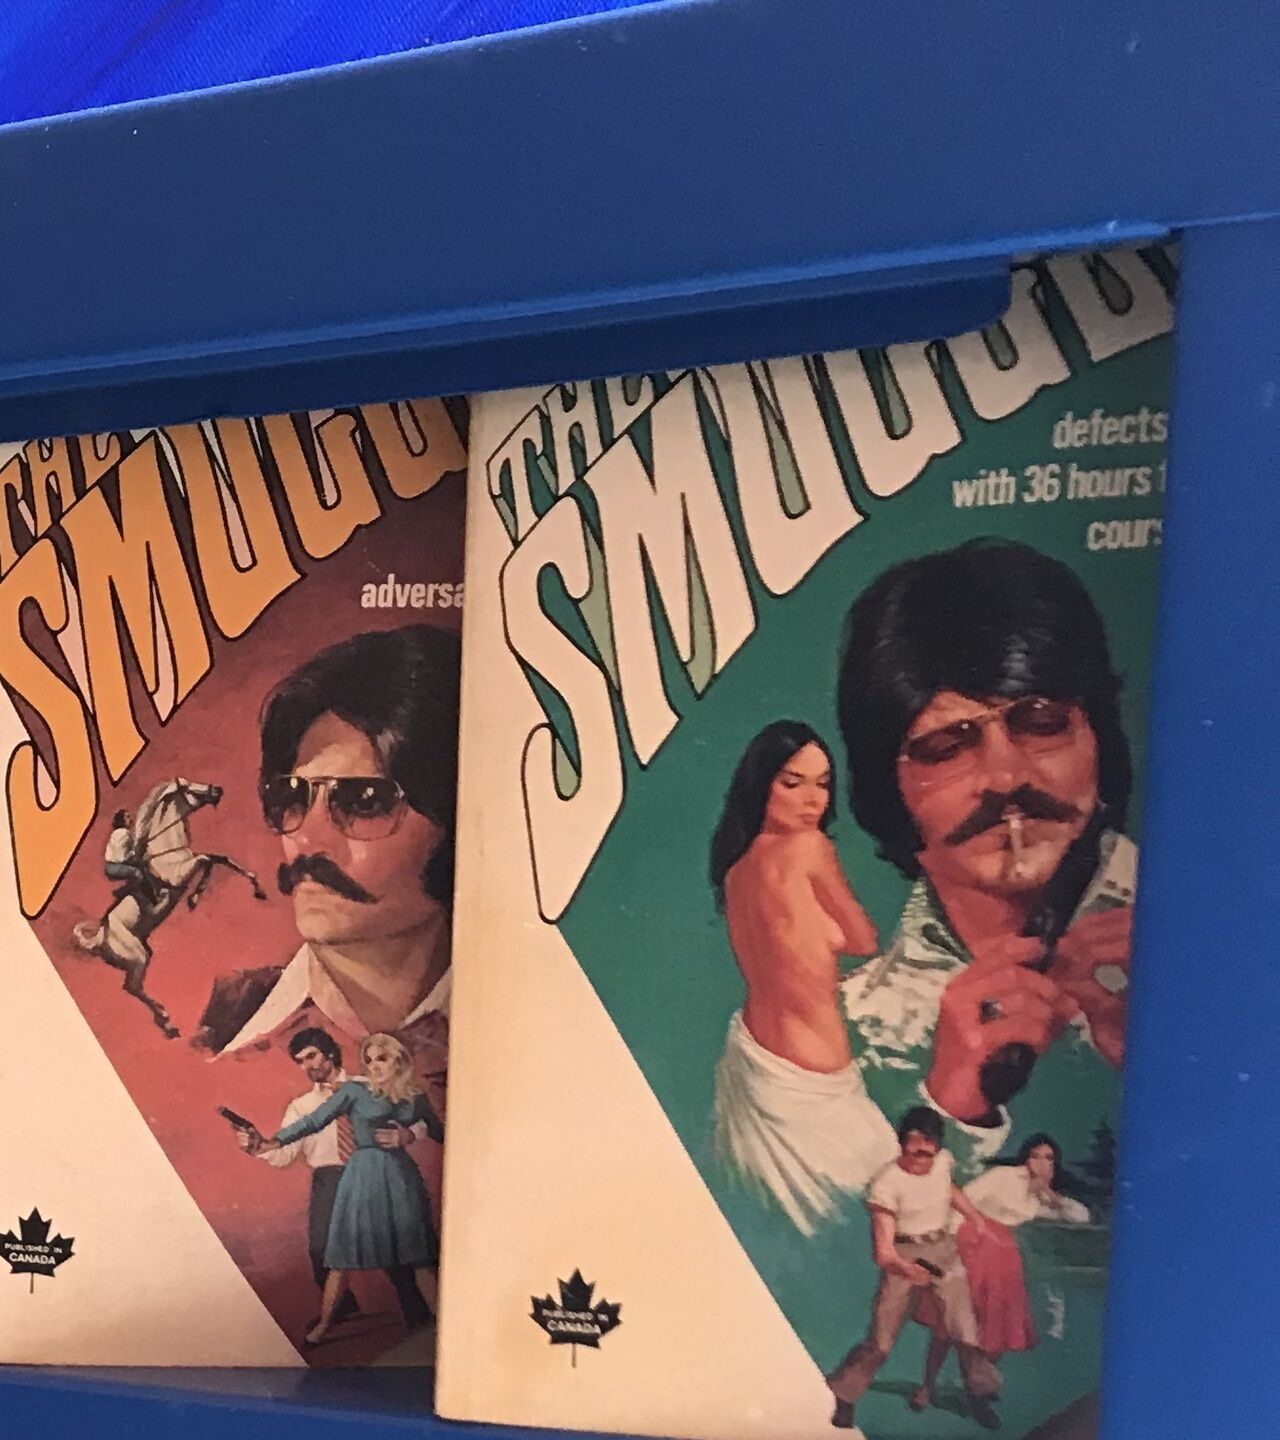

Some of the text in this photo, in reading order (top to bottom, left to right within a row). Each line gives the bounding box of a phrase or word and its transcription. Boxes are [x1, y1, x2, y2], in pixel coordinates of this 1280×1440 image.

[1053, 409, 1168, 450] defects
[487, 365, 692, 546] THE
[952, 462, 1151, 509] with 36 hours
[500, 244, 1180, 926] SMUGGL
[4, 1242, 50, 1253] PUBLISHED
[8, 1252, 56, 1265] CANADA
